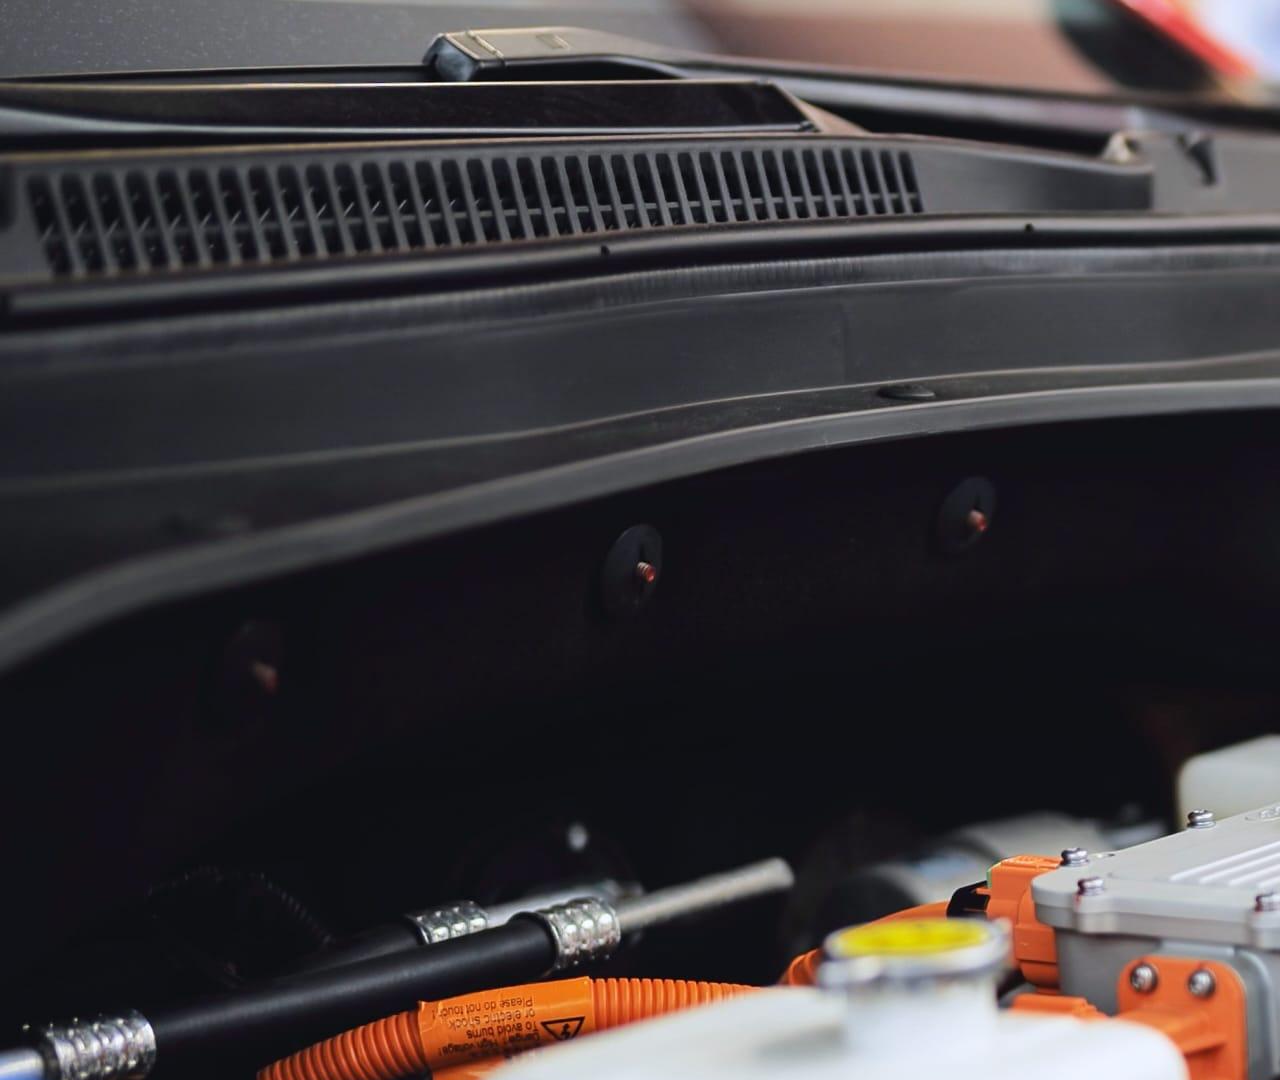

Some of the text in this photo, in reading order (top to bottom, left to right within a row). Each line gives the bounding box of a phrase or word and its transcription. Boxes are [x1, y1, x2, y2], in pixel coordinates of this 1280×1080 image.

[484, 1001, 497, 1009] do
[500, 996, 533, 1007] Please
[466, 1003, 481, 1013] not
[525, 1009, 536, 1017] or
[485, 1010, 521, 1022] electric
[466, 1021, 539, 1038] To avoid burns
